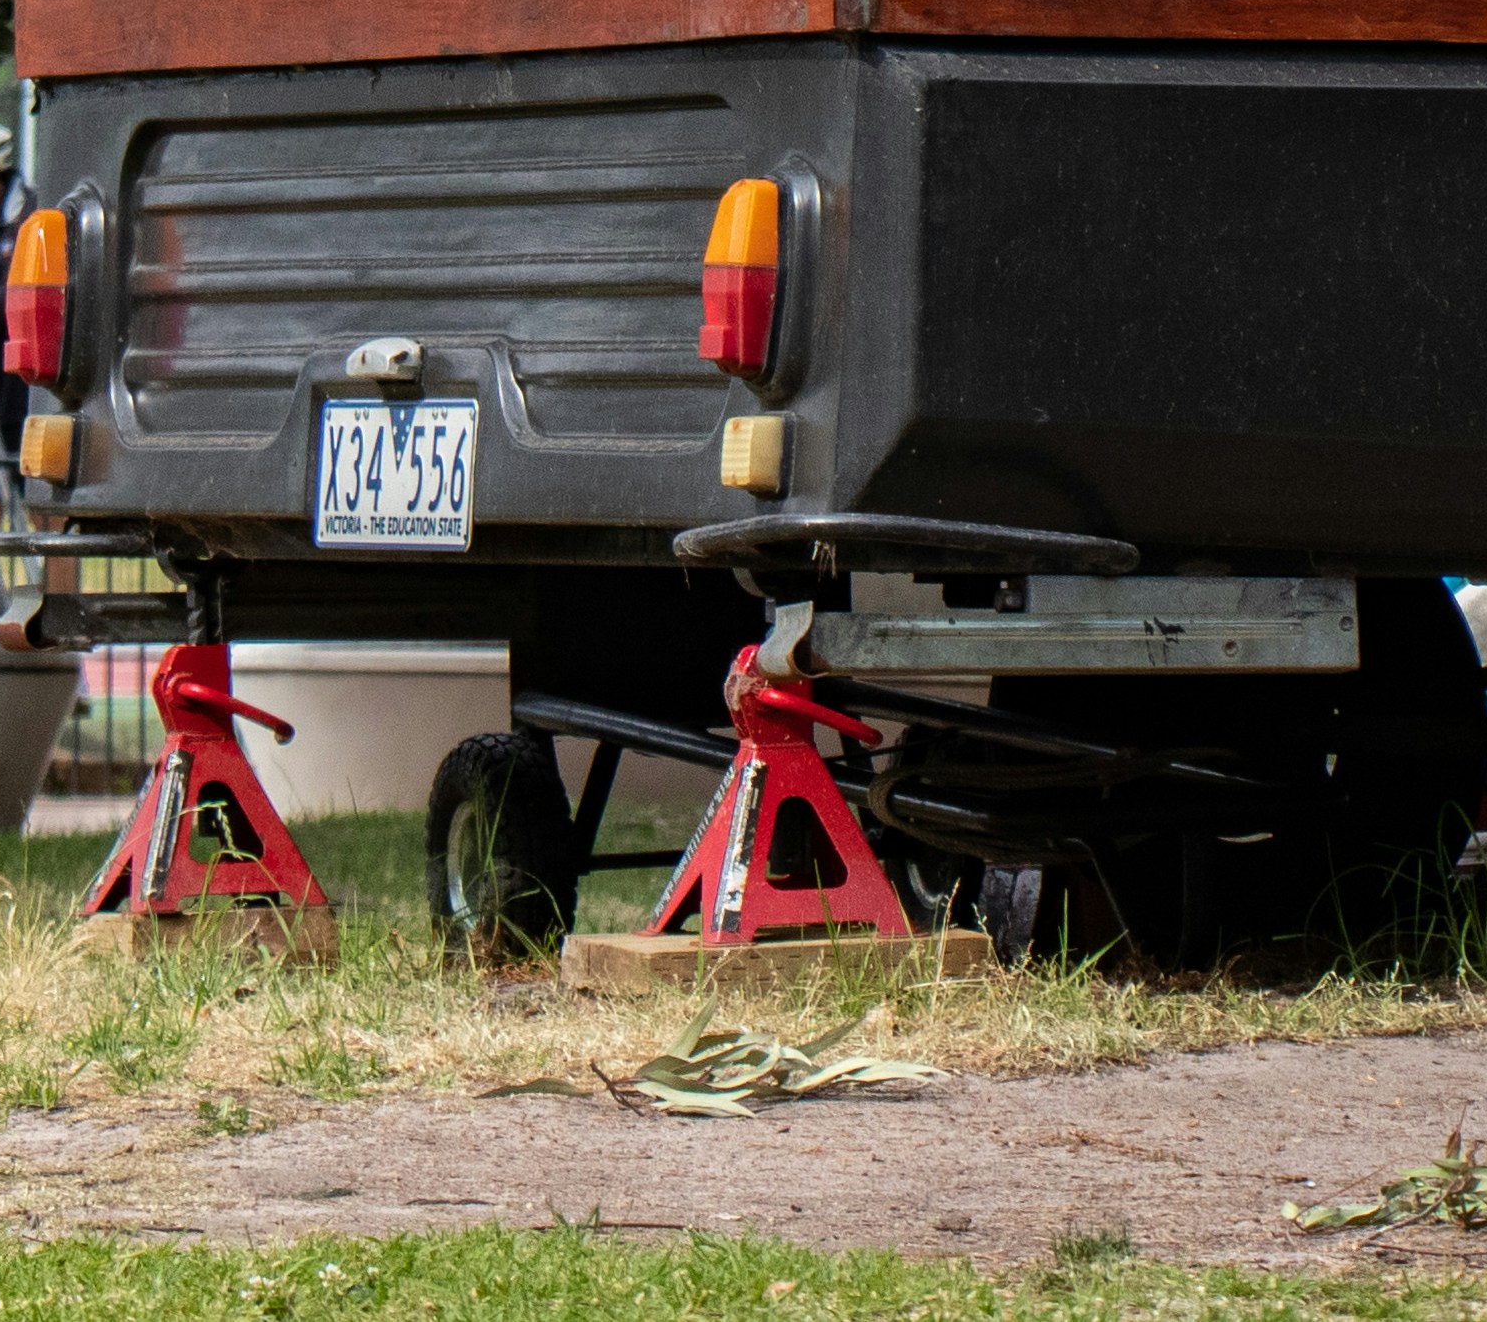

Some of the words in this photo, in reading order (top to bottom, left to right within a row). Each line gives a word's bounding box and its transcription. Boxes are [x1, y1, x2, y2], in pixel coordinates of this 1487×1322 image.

[324, 426, 385, 513] X34
[407, 425, 467, 513] 556
[325, 517, 361, 534] VICTORIA
[370, 517, 385, 534] THE
[387, 517, 435, 536] EDUCATION
[438, 518, 462, 536] STATE
